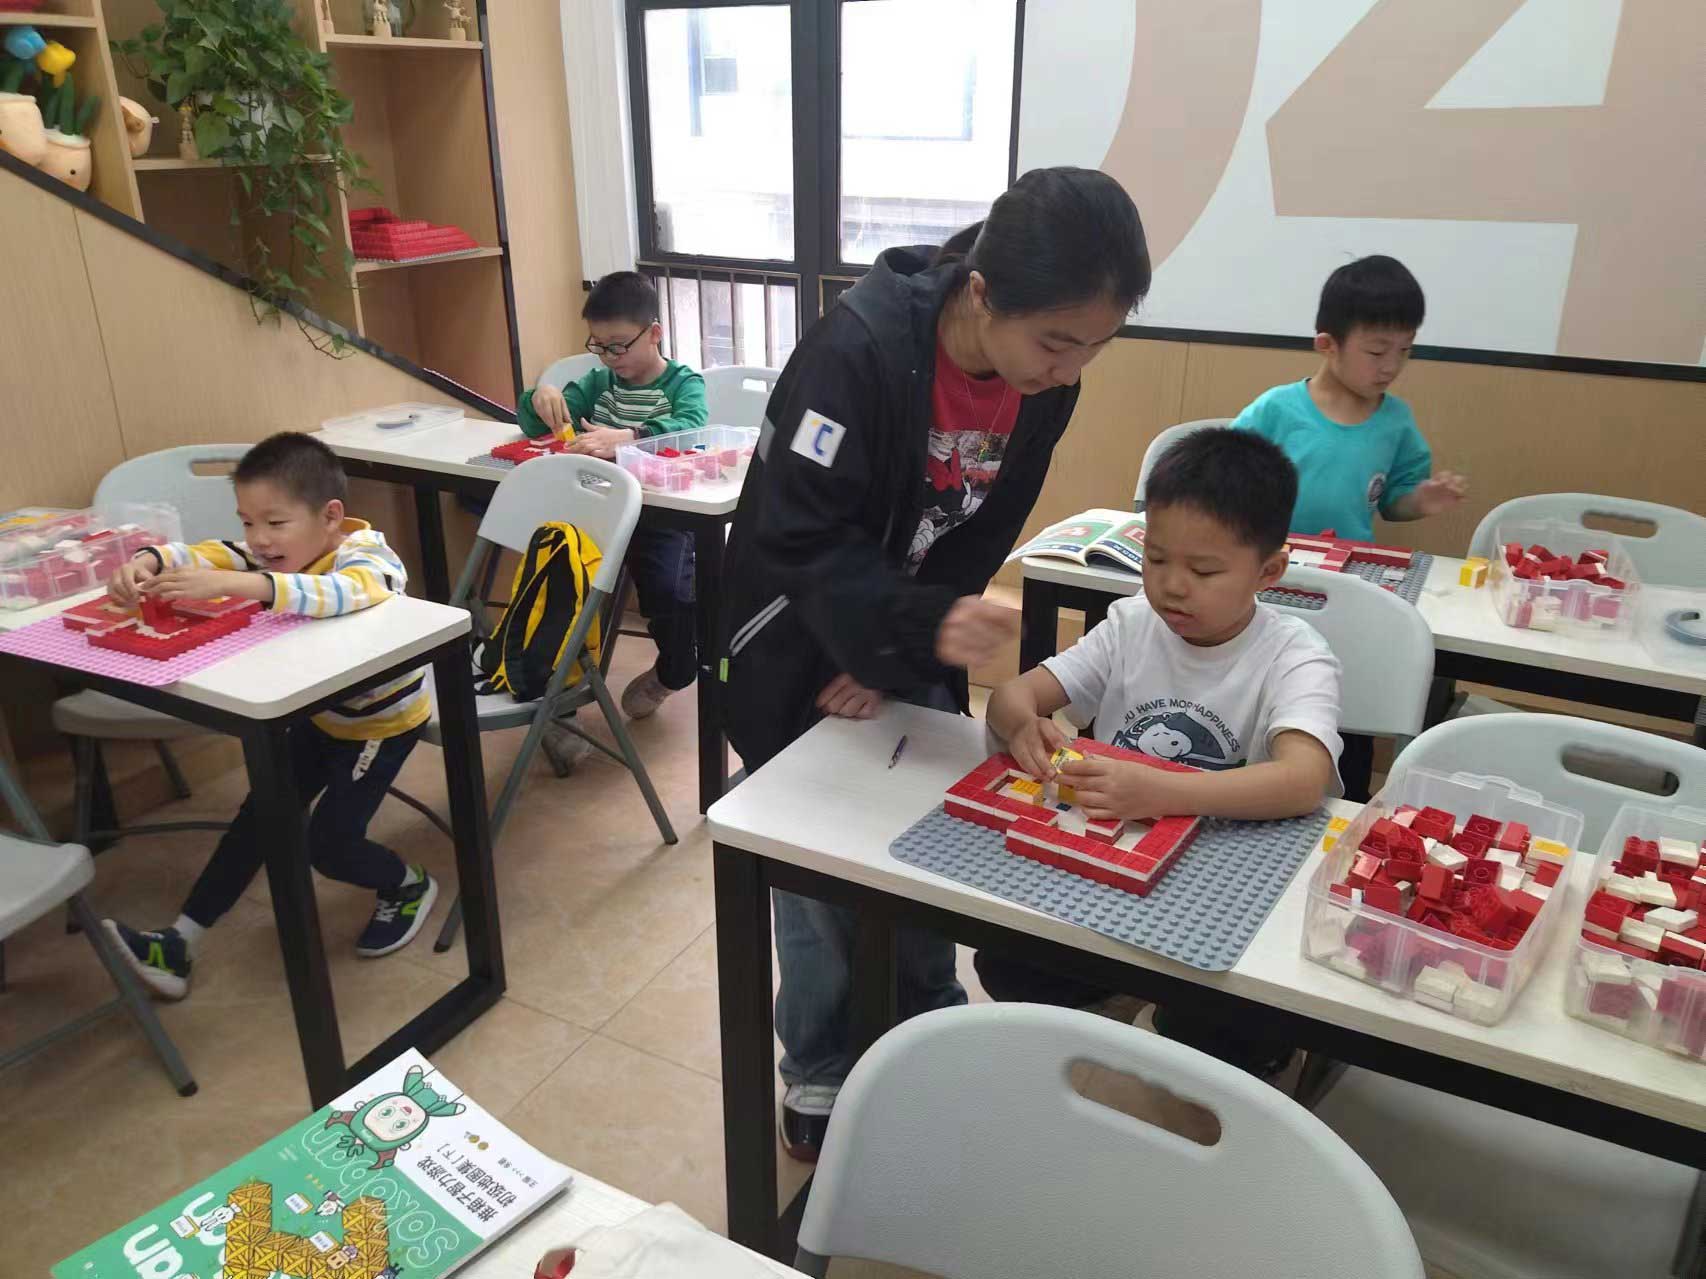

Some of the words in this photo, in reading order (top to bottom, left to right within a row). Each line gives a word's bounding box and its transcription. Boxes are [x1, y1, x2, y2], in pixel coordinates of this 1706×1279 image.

[1136, 699, 1167, 714] HAVE
[416, 1155, 498, 1223] 推箱子智力游戏
